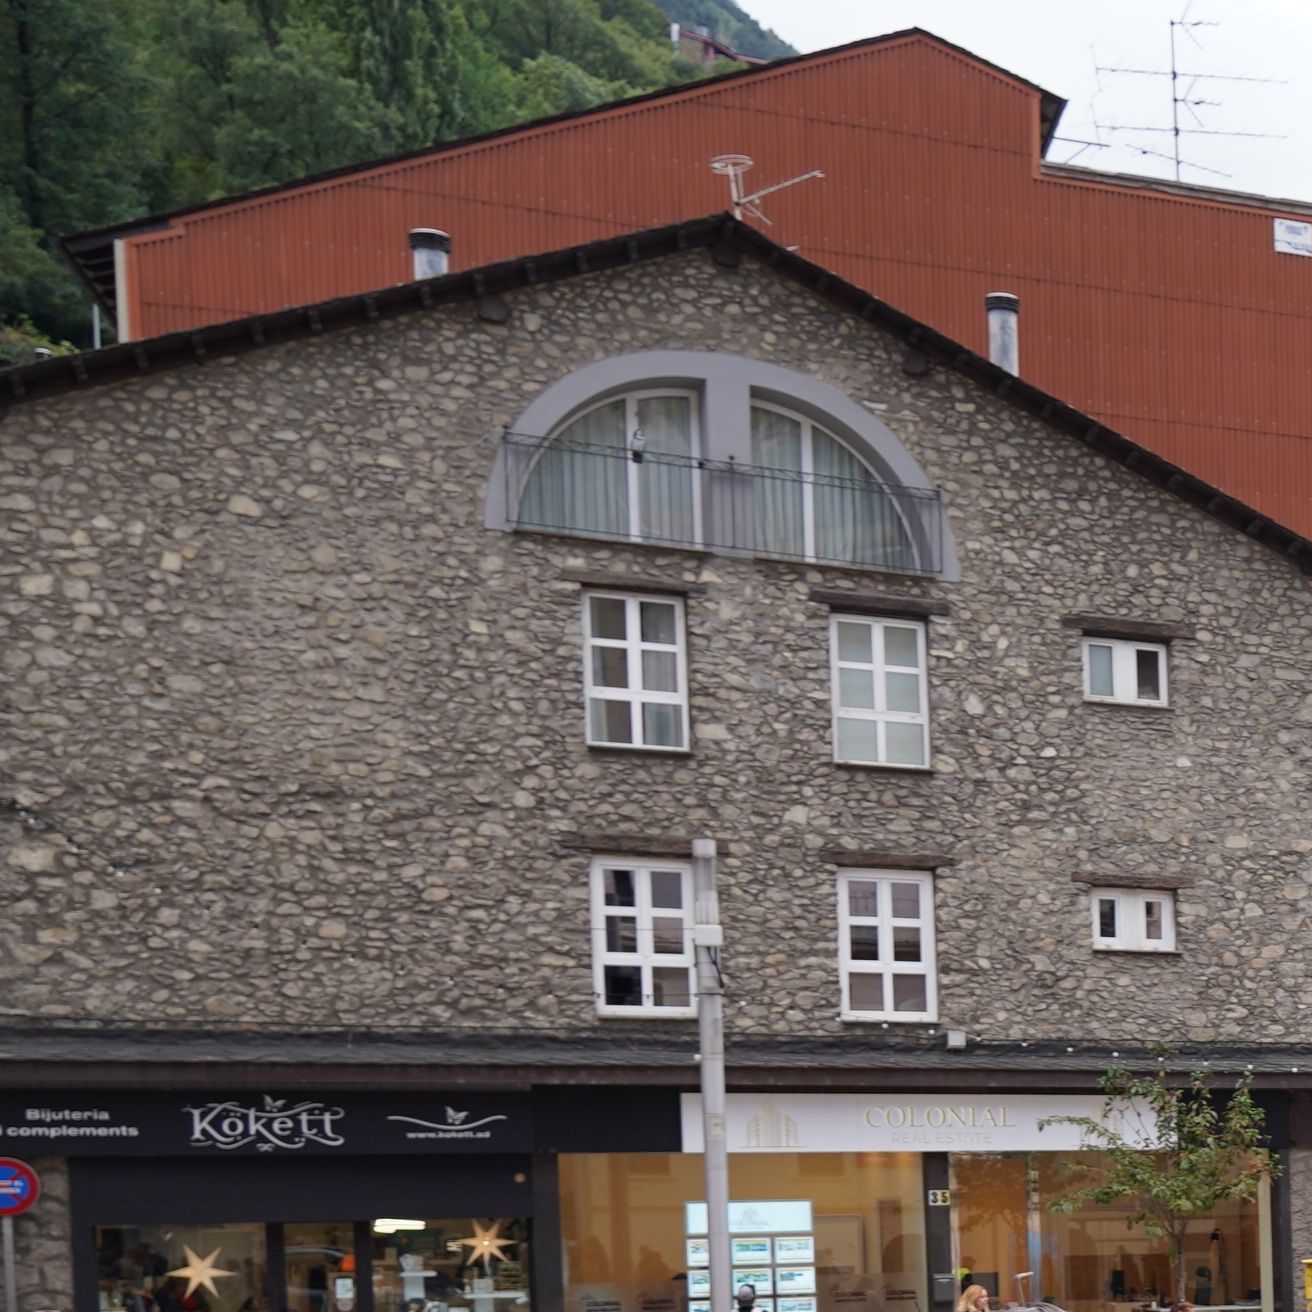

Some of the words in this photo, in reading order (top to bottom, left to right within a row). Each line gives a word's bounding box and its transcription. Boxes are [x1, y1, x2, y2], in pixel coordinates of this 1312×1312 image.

[25, 1108, 110, 1123] Bijuteria
[863, 1104, 1017, 1128] COLONIAL
[6, 1125, 140, 1139] complements
[891, 1132, 931, 1145] REAL
[931, 1191, 949, 1204] 35
